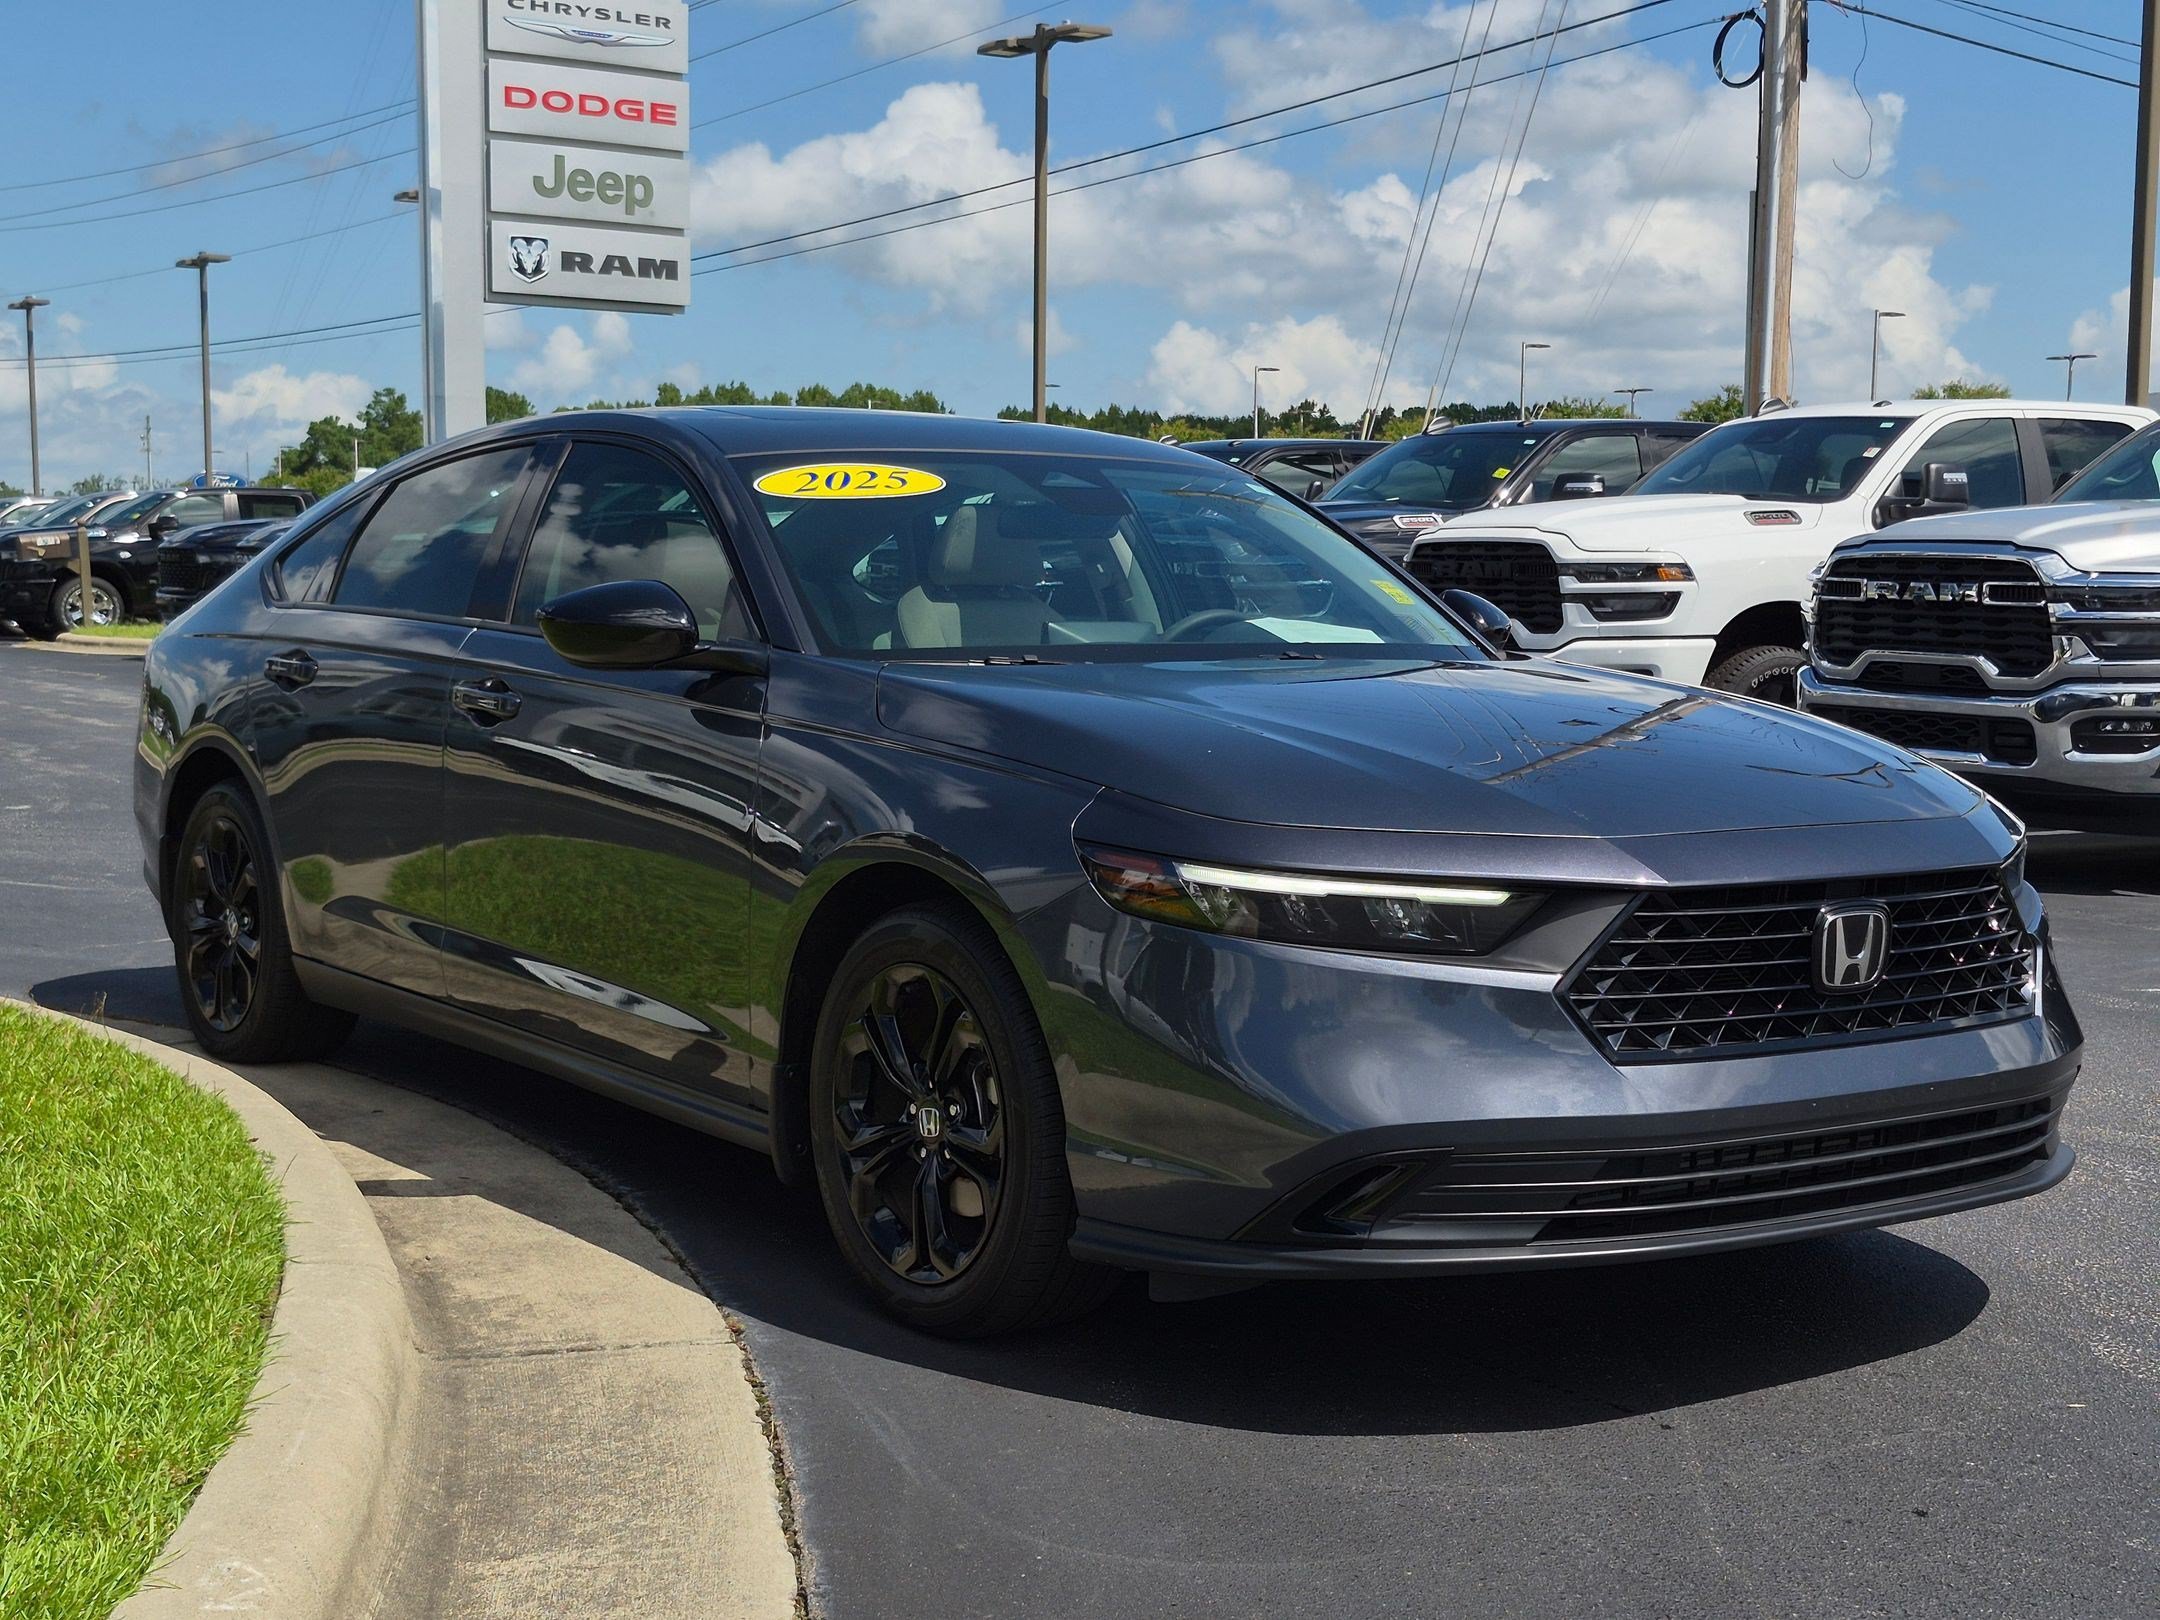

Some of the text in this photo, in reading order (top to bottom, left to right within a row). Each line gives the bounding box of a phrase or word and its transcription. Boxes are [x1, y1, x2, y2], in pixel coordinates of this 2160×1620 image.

[508, 0, 671, 29] CHRYSLER
[504, 85, 677, 126] DODGE
[532, 154, 654, 215] Jeep
[560, 250, 679, 281] RAM
[793, 470, 909, 493] 2025
[1433, 560, 1513, 577] RAM
[1866, 581, 1979, 602] RAM
